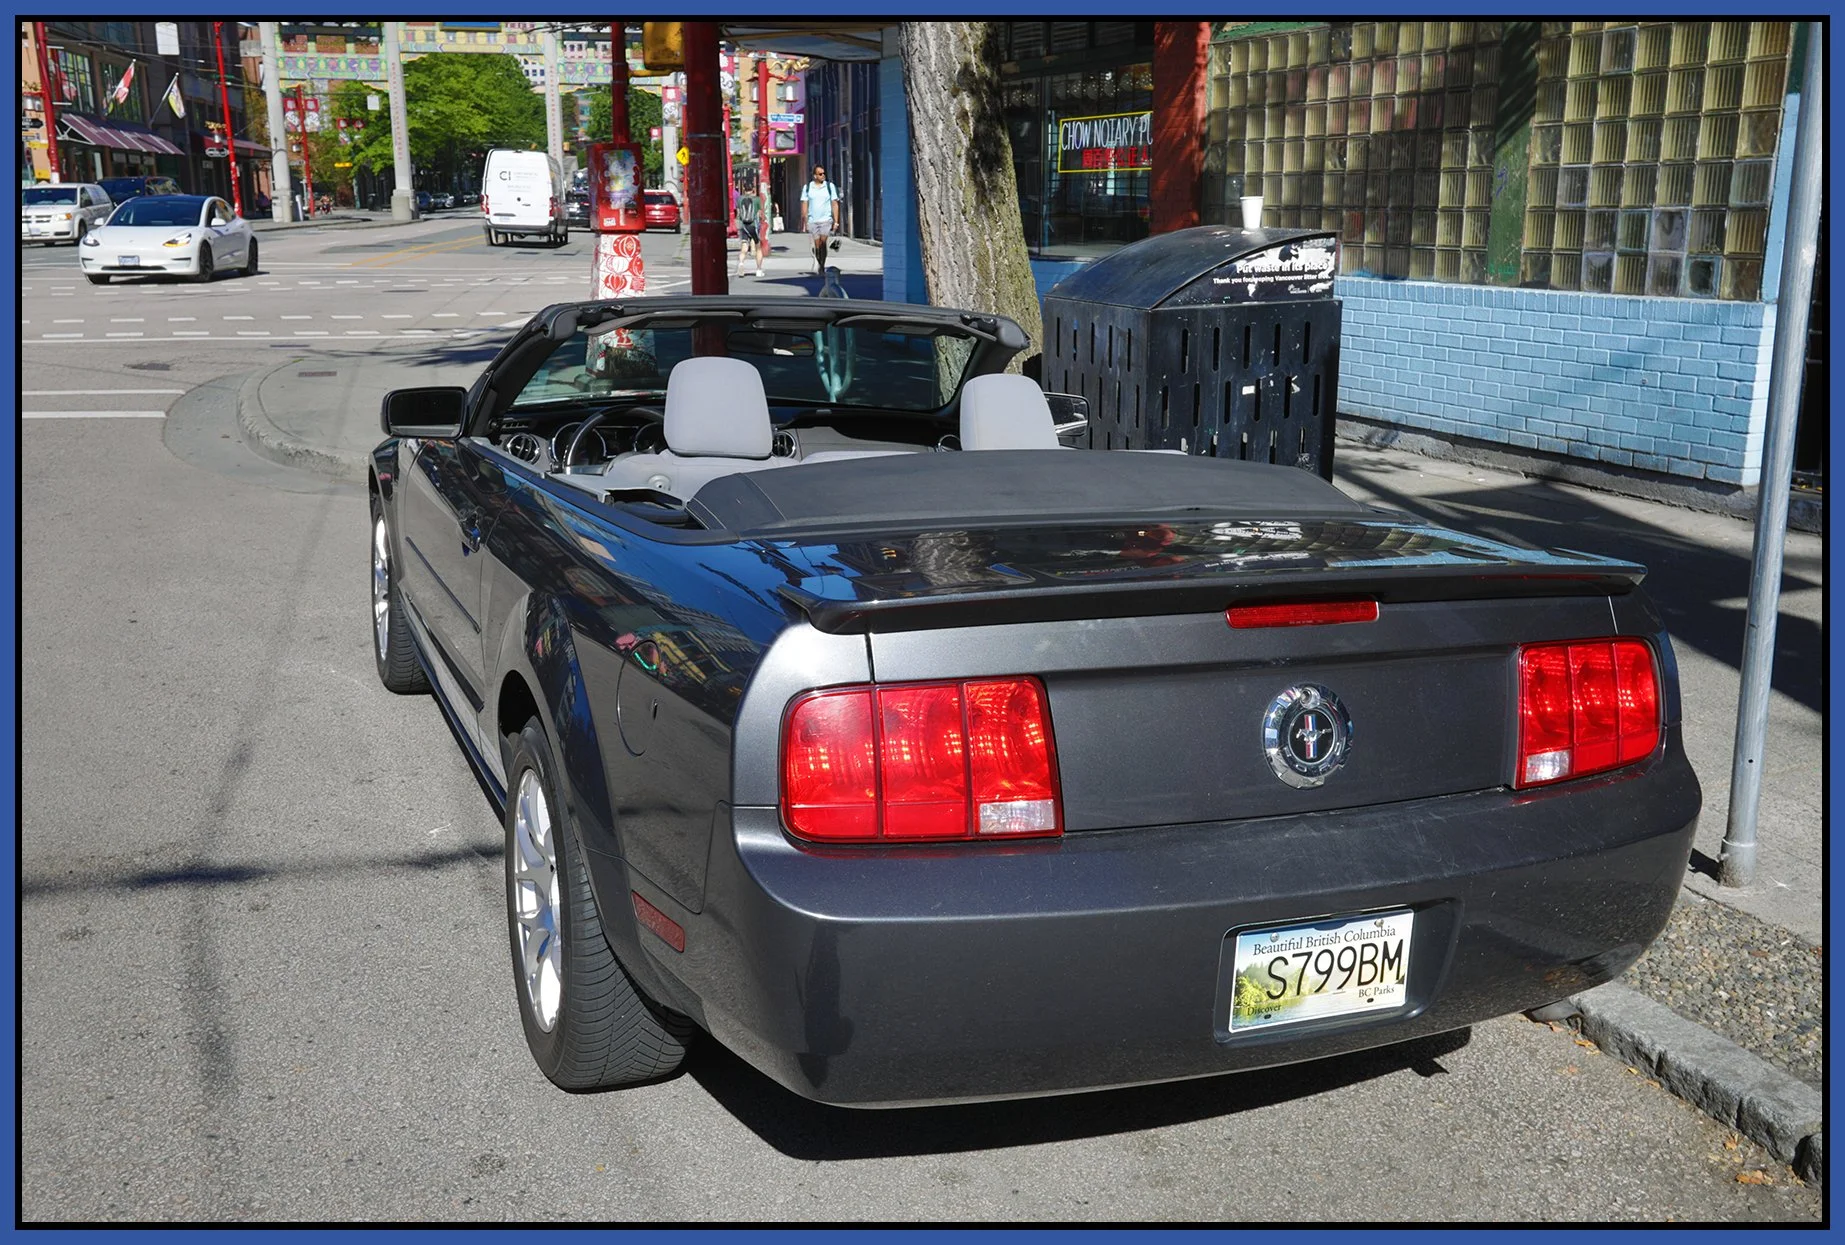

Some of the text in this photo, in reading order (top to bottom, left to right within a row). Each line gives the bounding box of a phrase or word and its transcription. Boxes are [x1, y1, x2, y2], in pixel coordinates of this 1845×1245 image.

[1061, 120, 1092, 150] CHOW
[1093, 116, 1139, 148] NOTARY
[499, 170, 511, 181] CI
[1236, 263, 1252, 274] Put
[1254, 262, 1280, 273] waste
[1282, 261, 1291, 272] in
[1292, 260, 1303, 271] its
[1231, 277, 1243, 285] you
[1275, 274, 1303, 282] Vancouver
[1304, 273, 1318, 281] litter
[1253, 925, 1396, 956] Beautiful British Columbia
[1266, 938, 1404, 1000] S799BM
[1358, 985, 1395, 998] BC Parks
[1247, 1004, 1282, 1017] Discover
